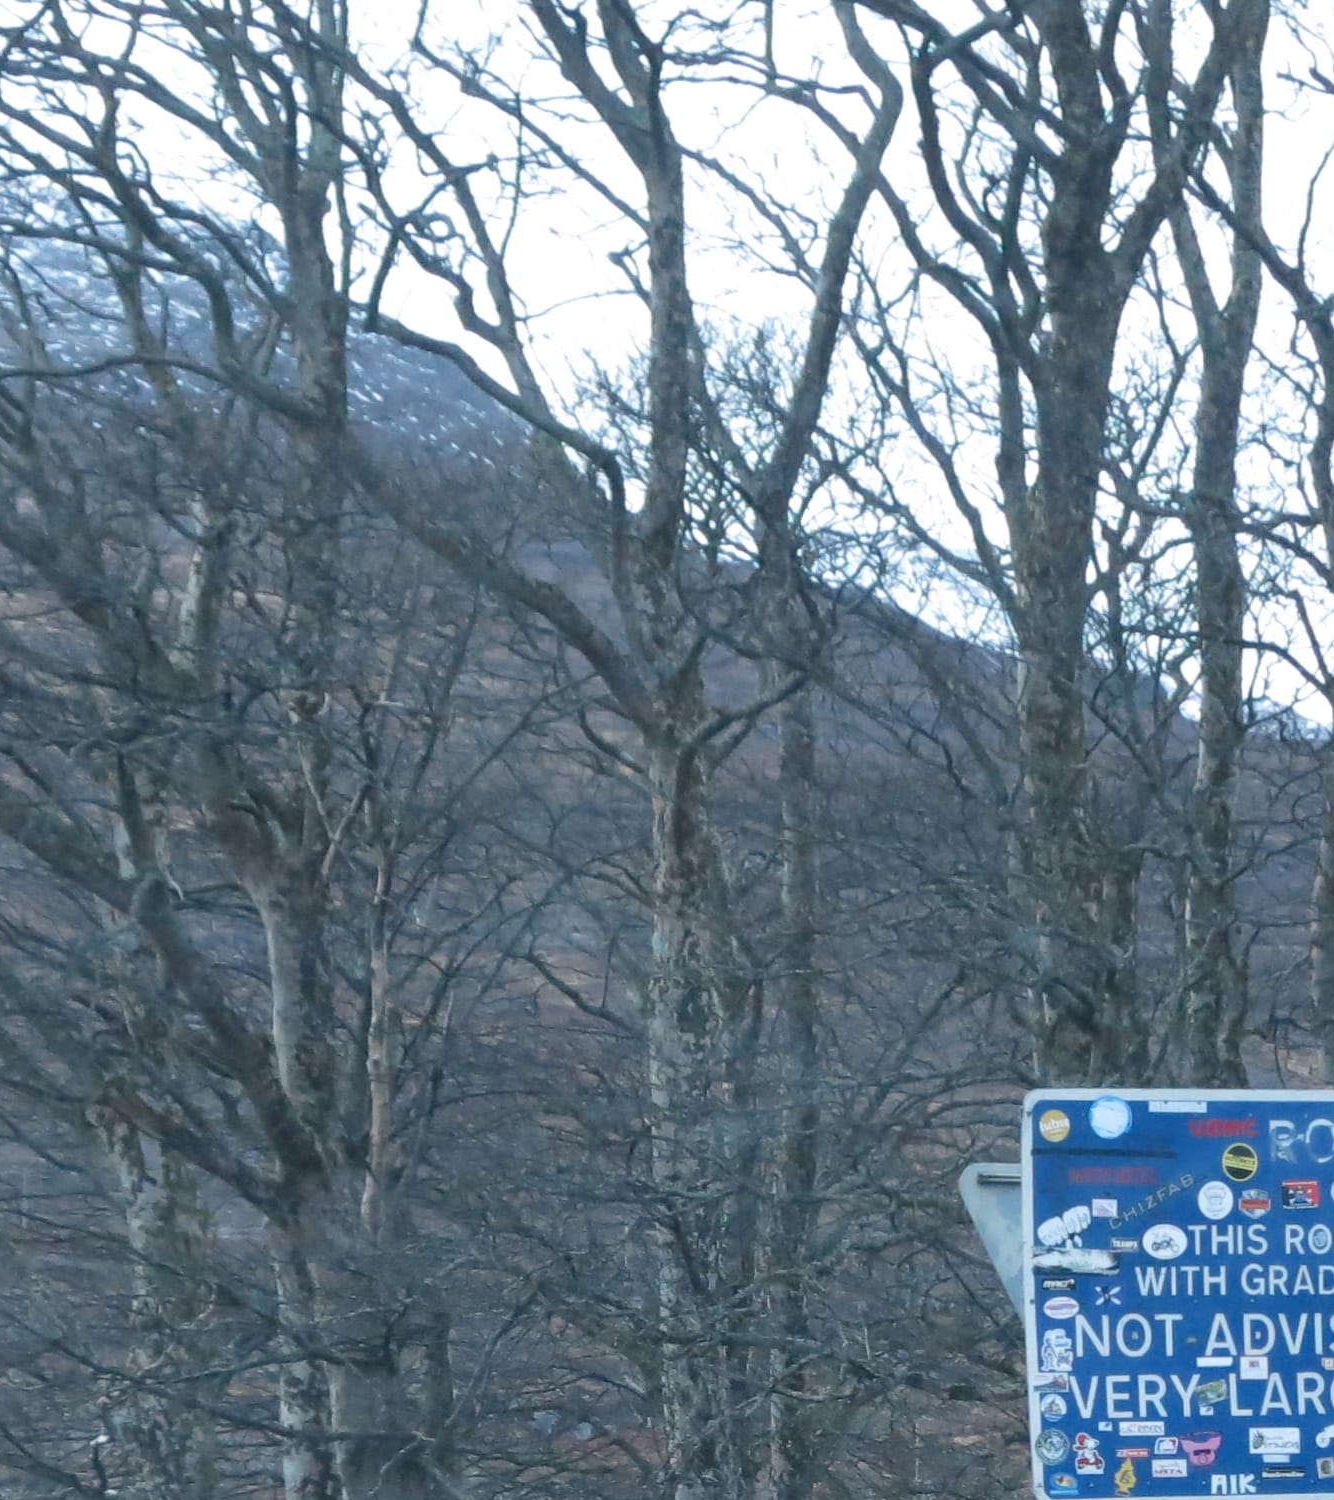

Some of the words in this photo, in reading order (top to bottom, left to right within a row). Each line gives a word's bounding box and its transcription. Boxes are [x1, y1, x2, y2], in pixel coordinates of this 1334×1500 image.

[1108, 1173, 1195, 1230] CHIZFAB
[1187, 1224, 1269, 1256] THIS
[1134, 1265, 1228, 1297] WITH
[1074, 1312, 1184, 1358] NOT
[1069, 1373, 1202, 1420] VERY
